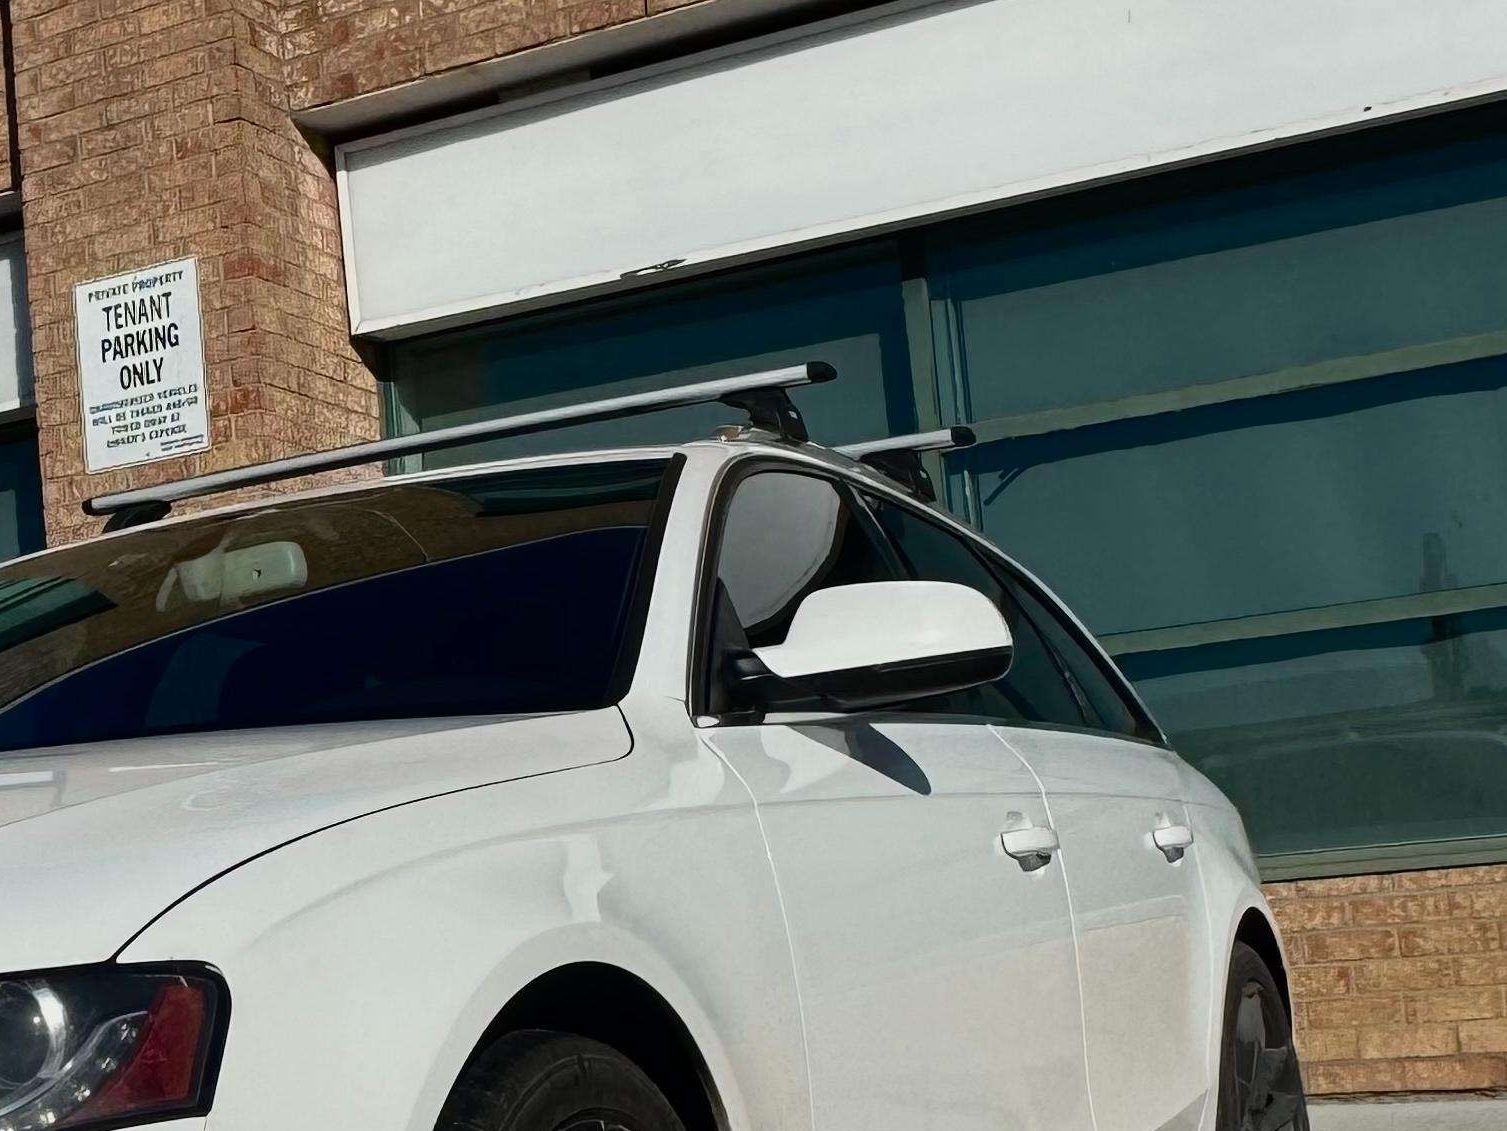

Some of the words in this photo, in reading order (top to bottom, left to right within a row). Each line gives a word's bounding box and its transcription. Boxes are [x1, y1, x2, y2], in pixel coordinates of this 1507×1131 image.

[101, 291, 172, 332] TENANT
[101, 322, 179, 363] PARKING
[119, 356, 164, 390] ONLY
